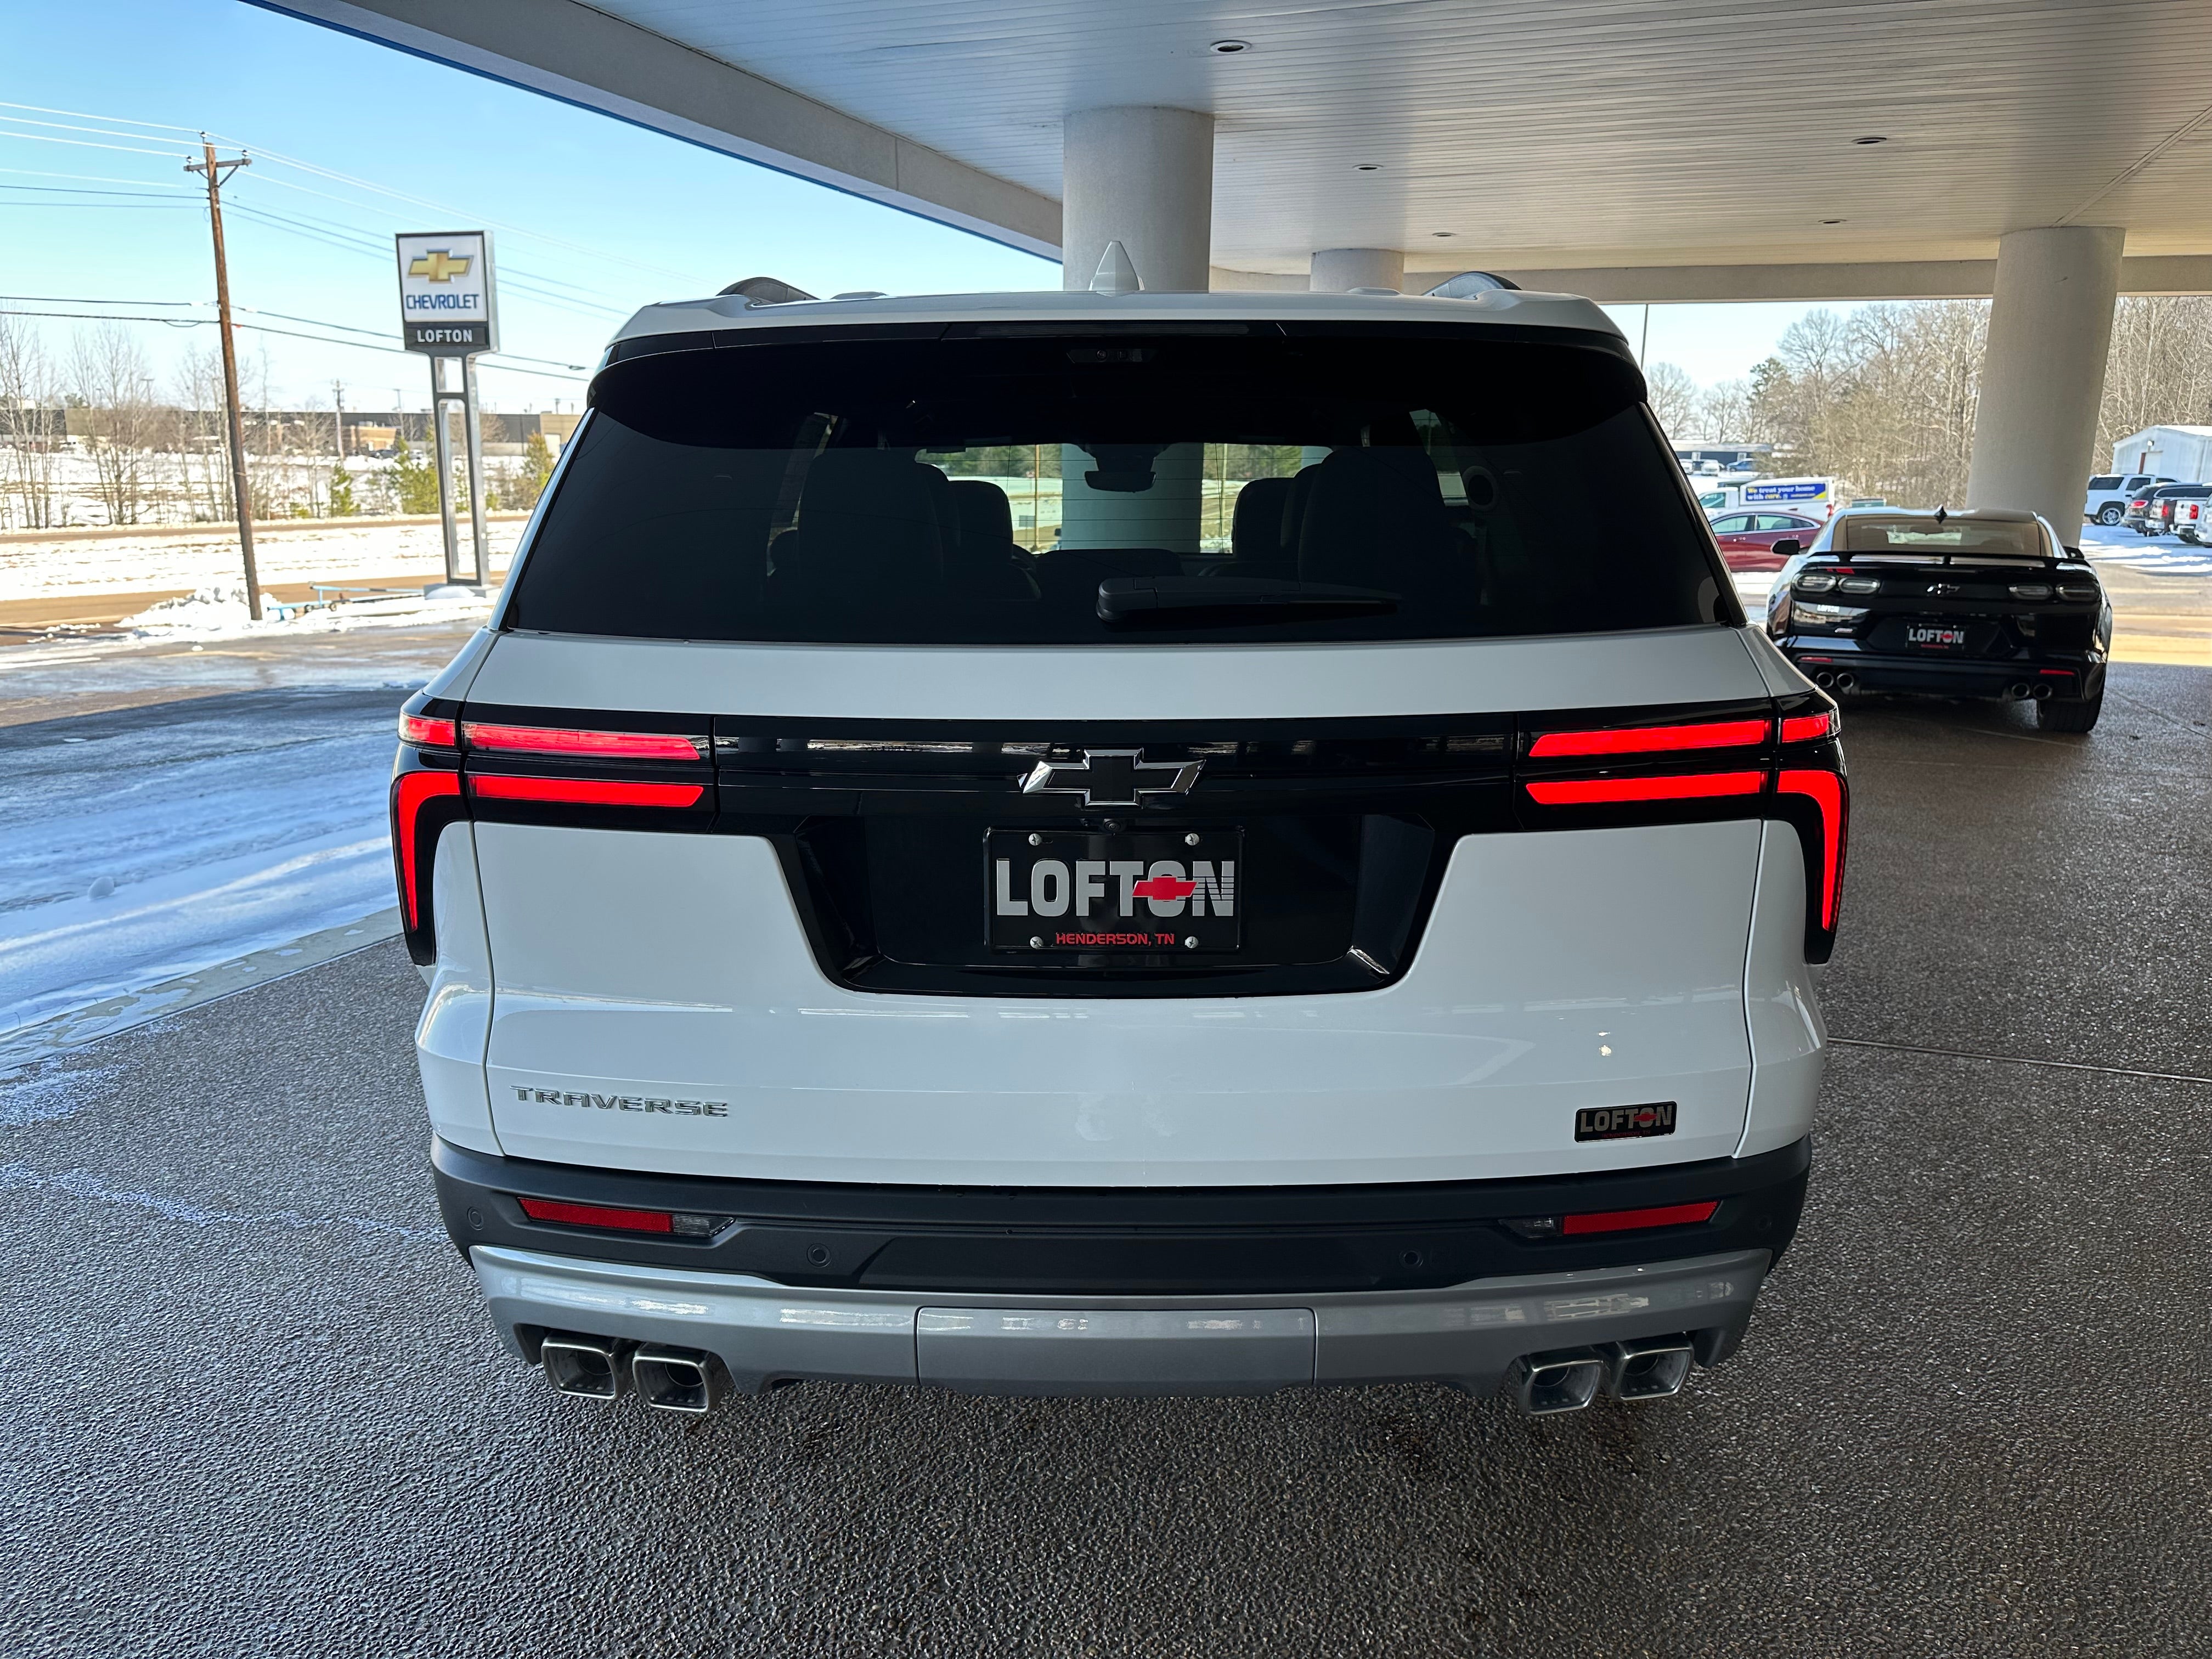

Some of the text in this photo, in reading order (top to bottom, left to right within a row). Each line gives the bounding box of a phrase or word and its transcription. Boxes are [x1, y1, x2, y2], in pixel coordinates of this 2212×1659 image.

[406, 294, 479, 309] CHEVROLET
[417, 329, 472, 342] LOFTON
[1908, 628, 1964, 644] LOFTON
[996, 858, 1235, 917] LOFTON
[1056, 933, 1175, 946] HENDERSON, TN
[509, 1085, 728, 1117] TRAVERSE
[1580, 1105, 1673, 1132] LOFTON
